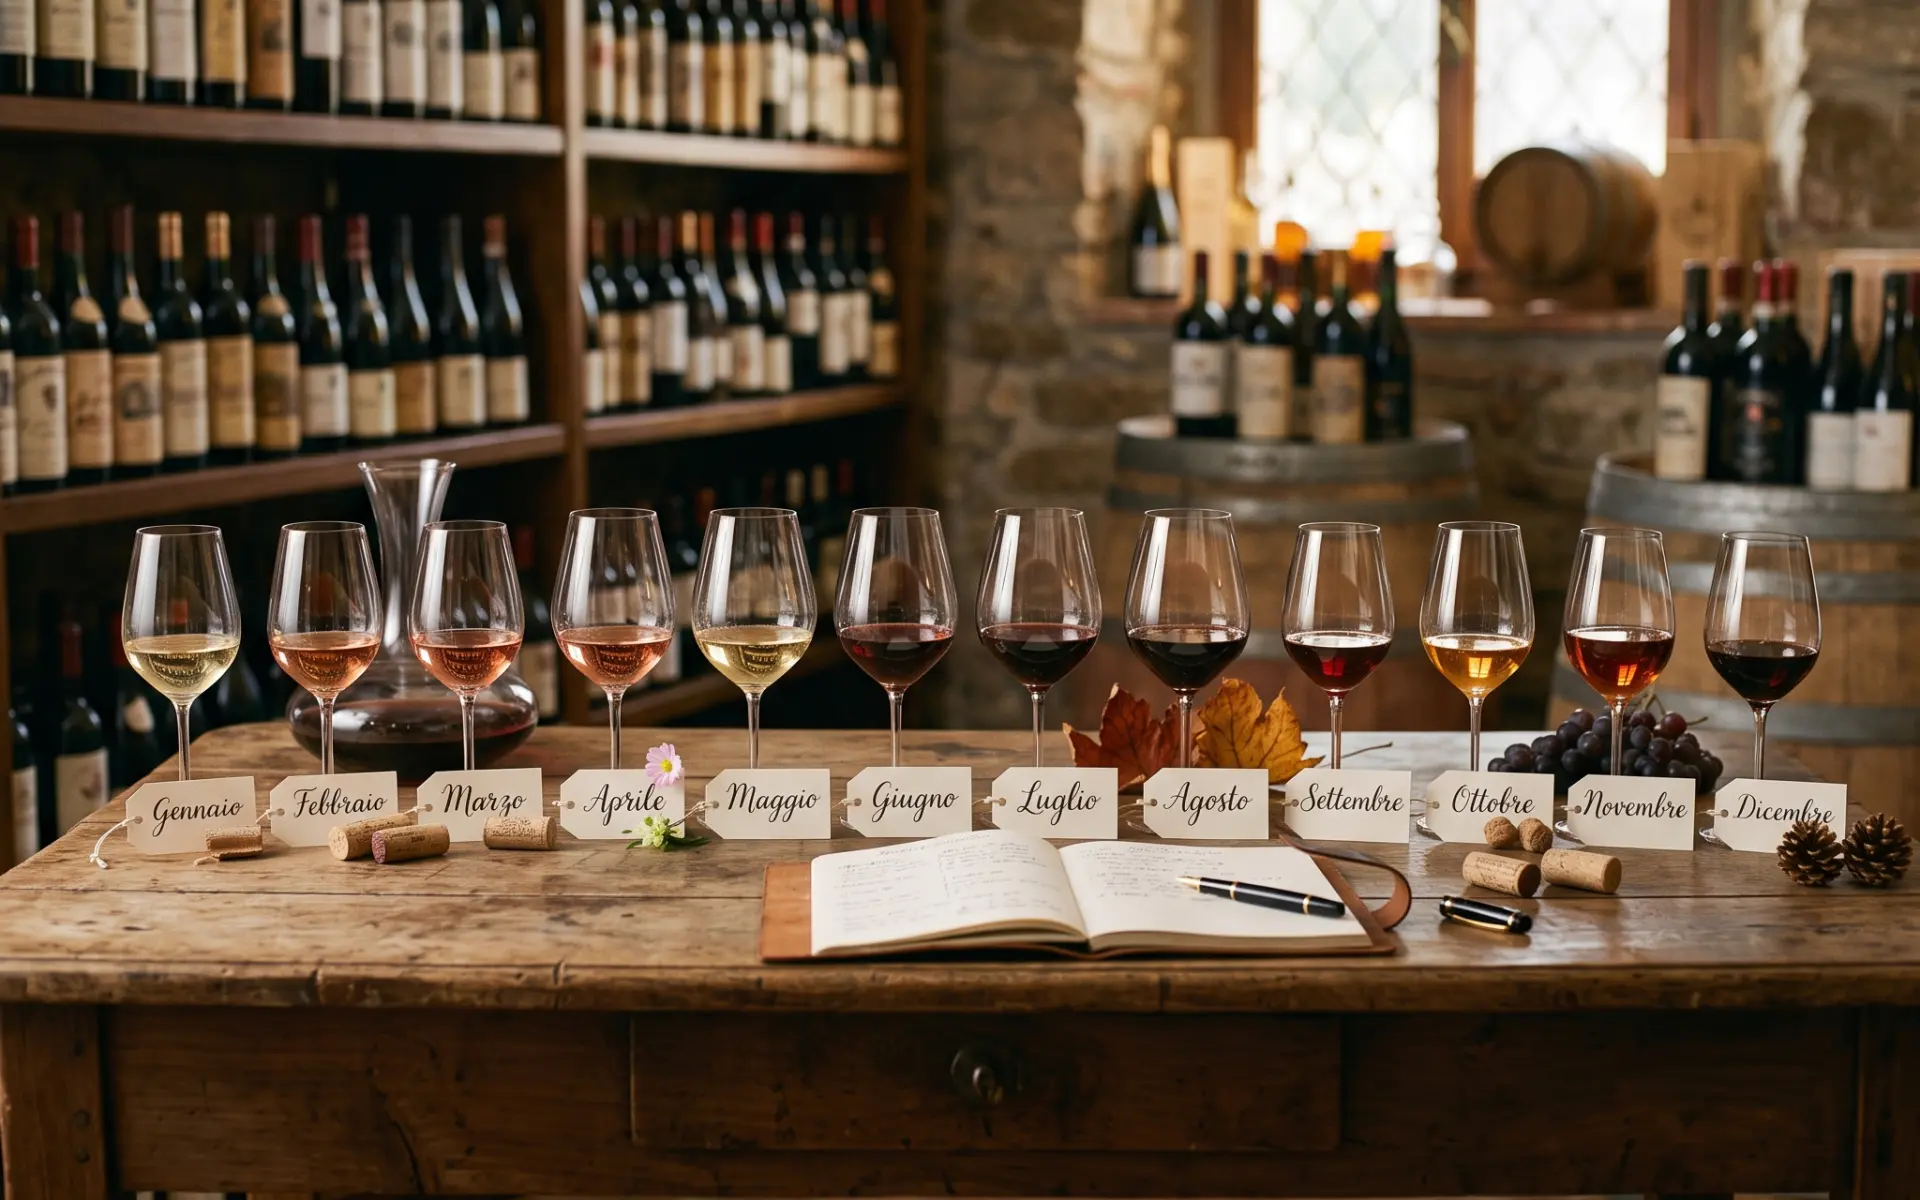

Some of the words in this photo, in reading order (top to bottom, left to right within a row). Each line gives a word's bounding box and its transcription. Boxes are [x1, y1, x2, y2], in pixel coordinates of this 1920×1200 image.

[293, 786, 388, 818] Febbraio
[441, 783, 527, 818] Marzo
[583, 782, 666, 827] Aprile
[725, 782, 821, 823] Maggio
[871, 780, 960, 823] Giugno
[1016, 779, 1101, 826] Luglio
[1162, 781, 1252, 827] Agosto
[1299, 782, 1405, 812] Settembre
[1451, 784, 1536, 814] Ottobre
[1581, 788, 1688, 819] Novembre
[1735, 793, 1835, 824] Dicembre
[152, 796, 245, 838] Gennaio
